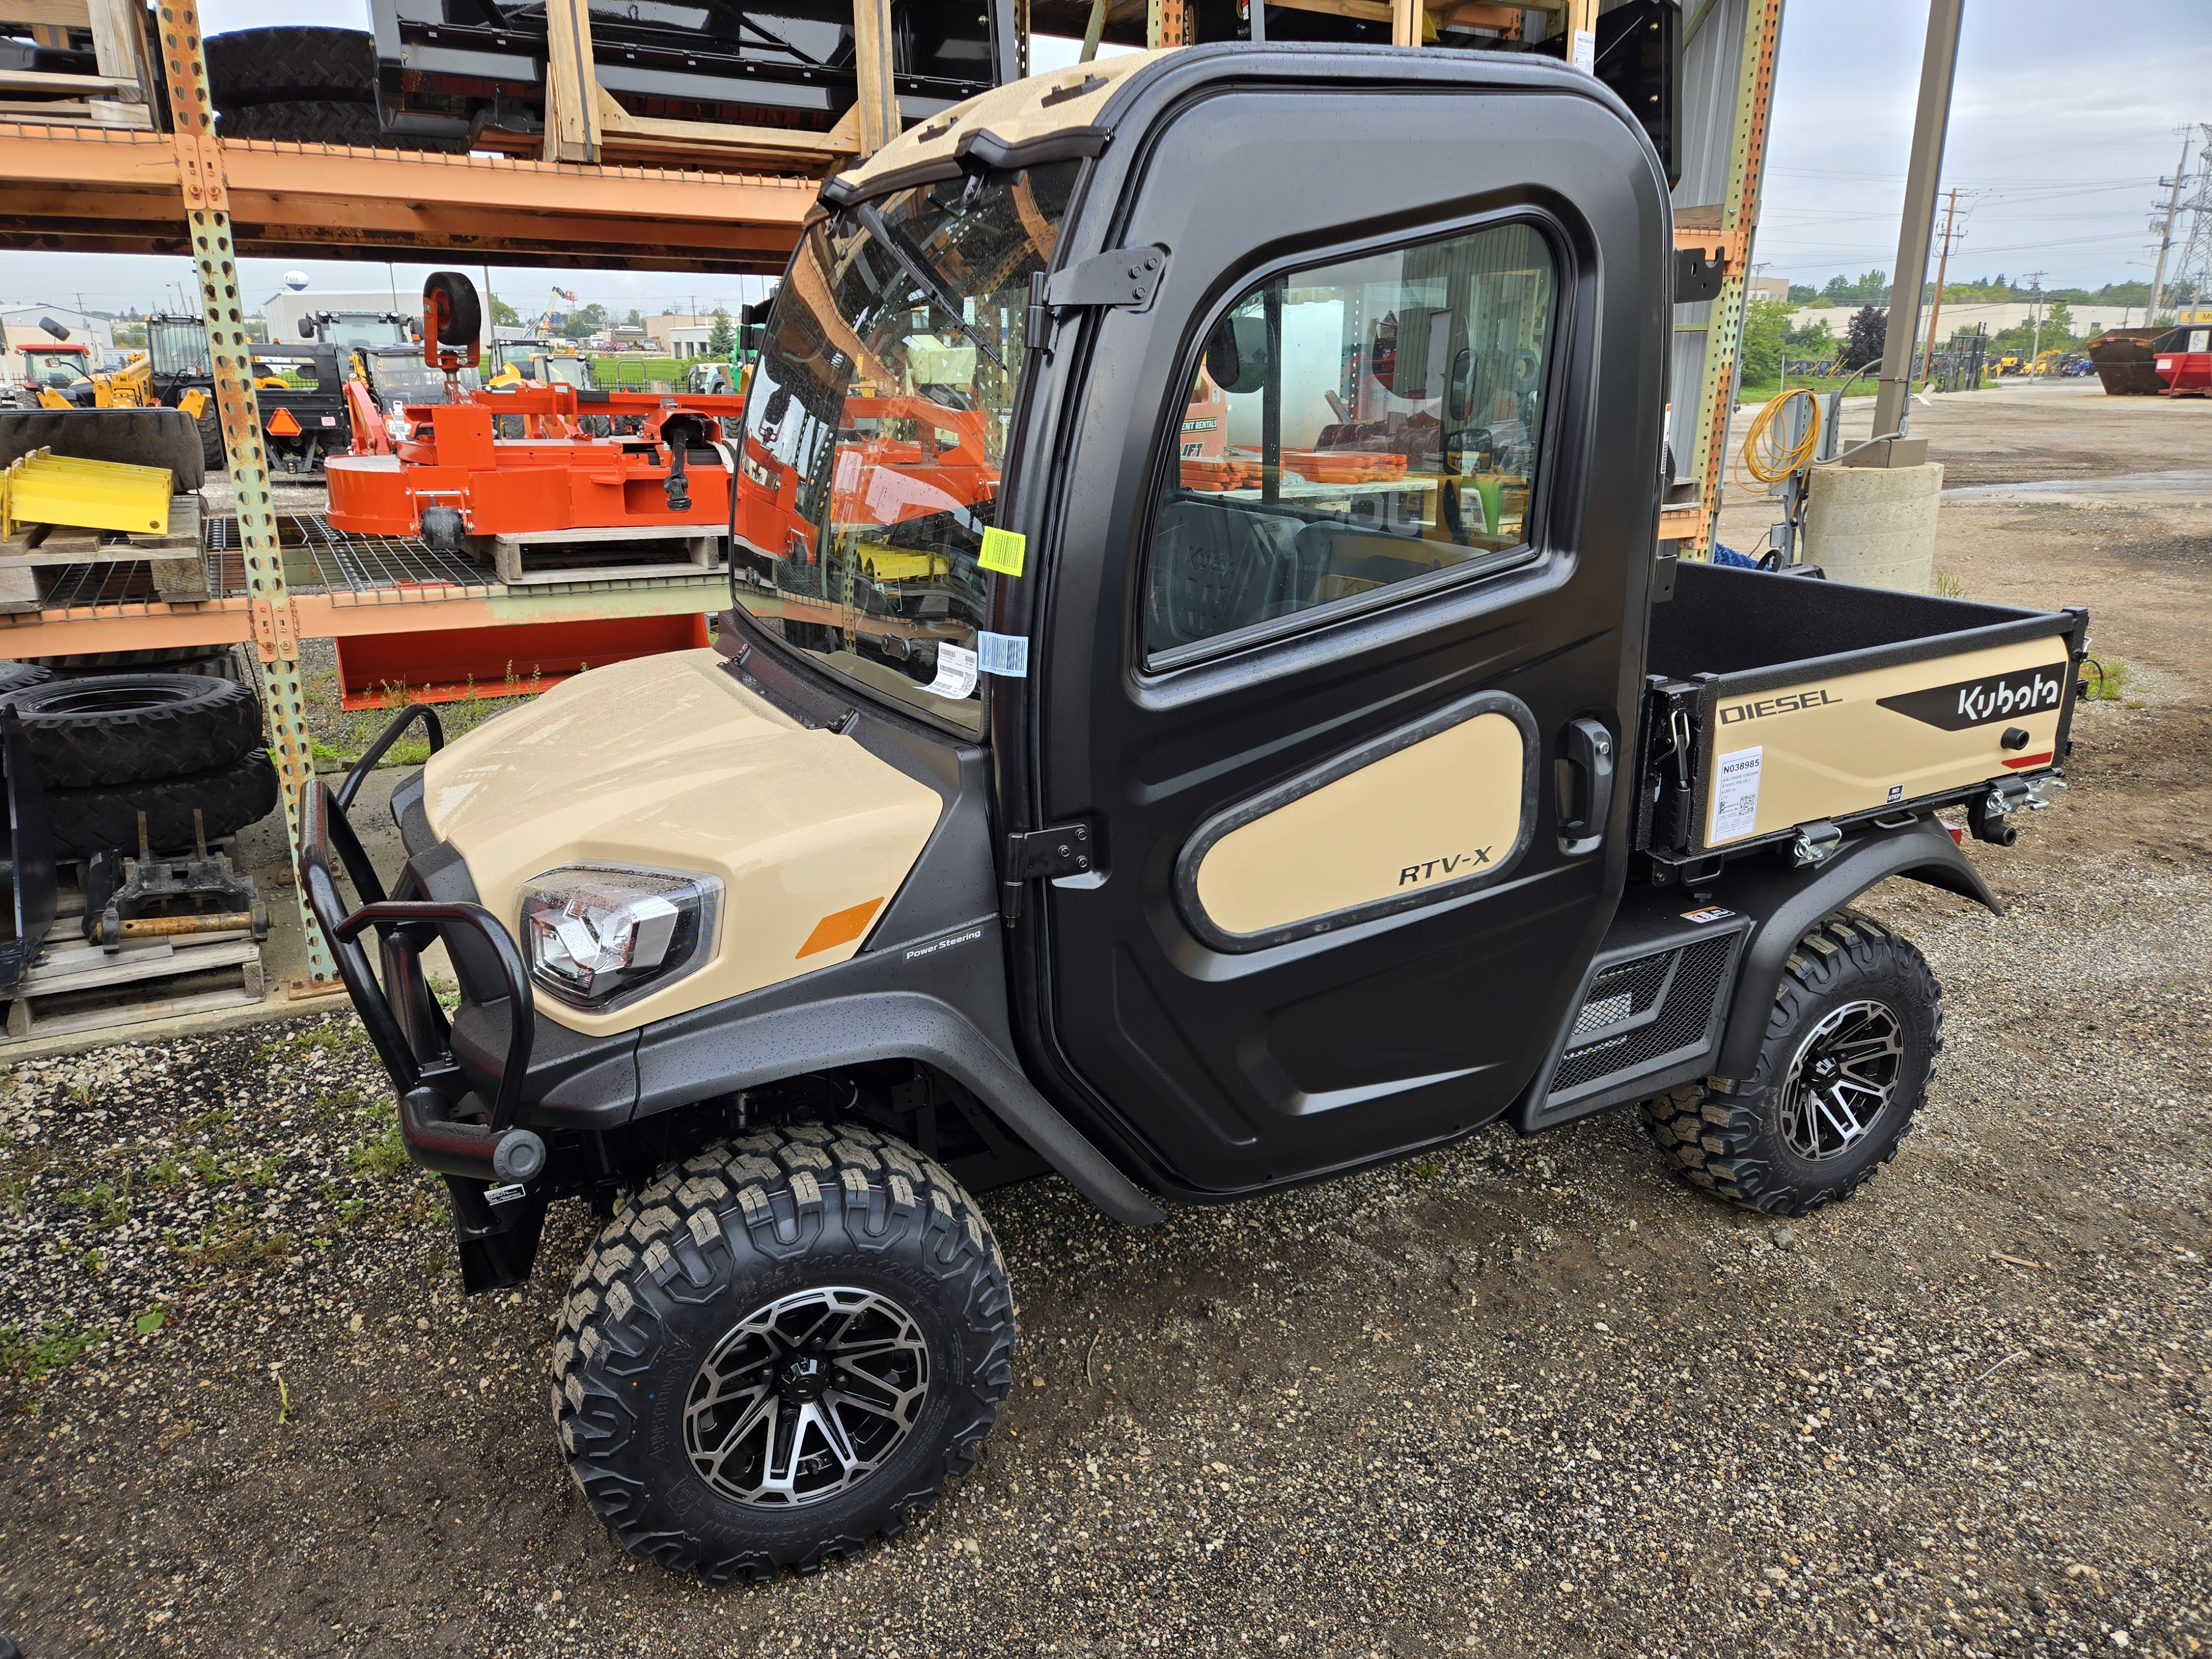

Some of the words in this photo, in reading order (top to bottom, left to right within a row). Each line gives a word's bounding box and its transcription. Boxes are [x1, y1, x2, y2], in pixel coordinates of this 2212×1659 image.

[1195, 420, 1217, 429] RENTALS
[1719, 690, 1843, 725] DIESEL
[1958, 674, 2058, 720] Kubota
[1723, 759, 1760, 774] N038985
[1399, 844, 1494, 886] RTV-X
[906, 945, 938, 959] Power
[938, 930, 981, 950] Steering
